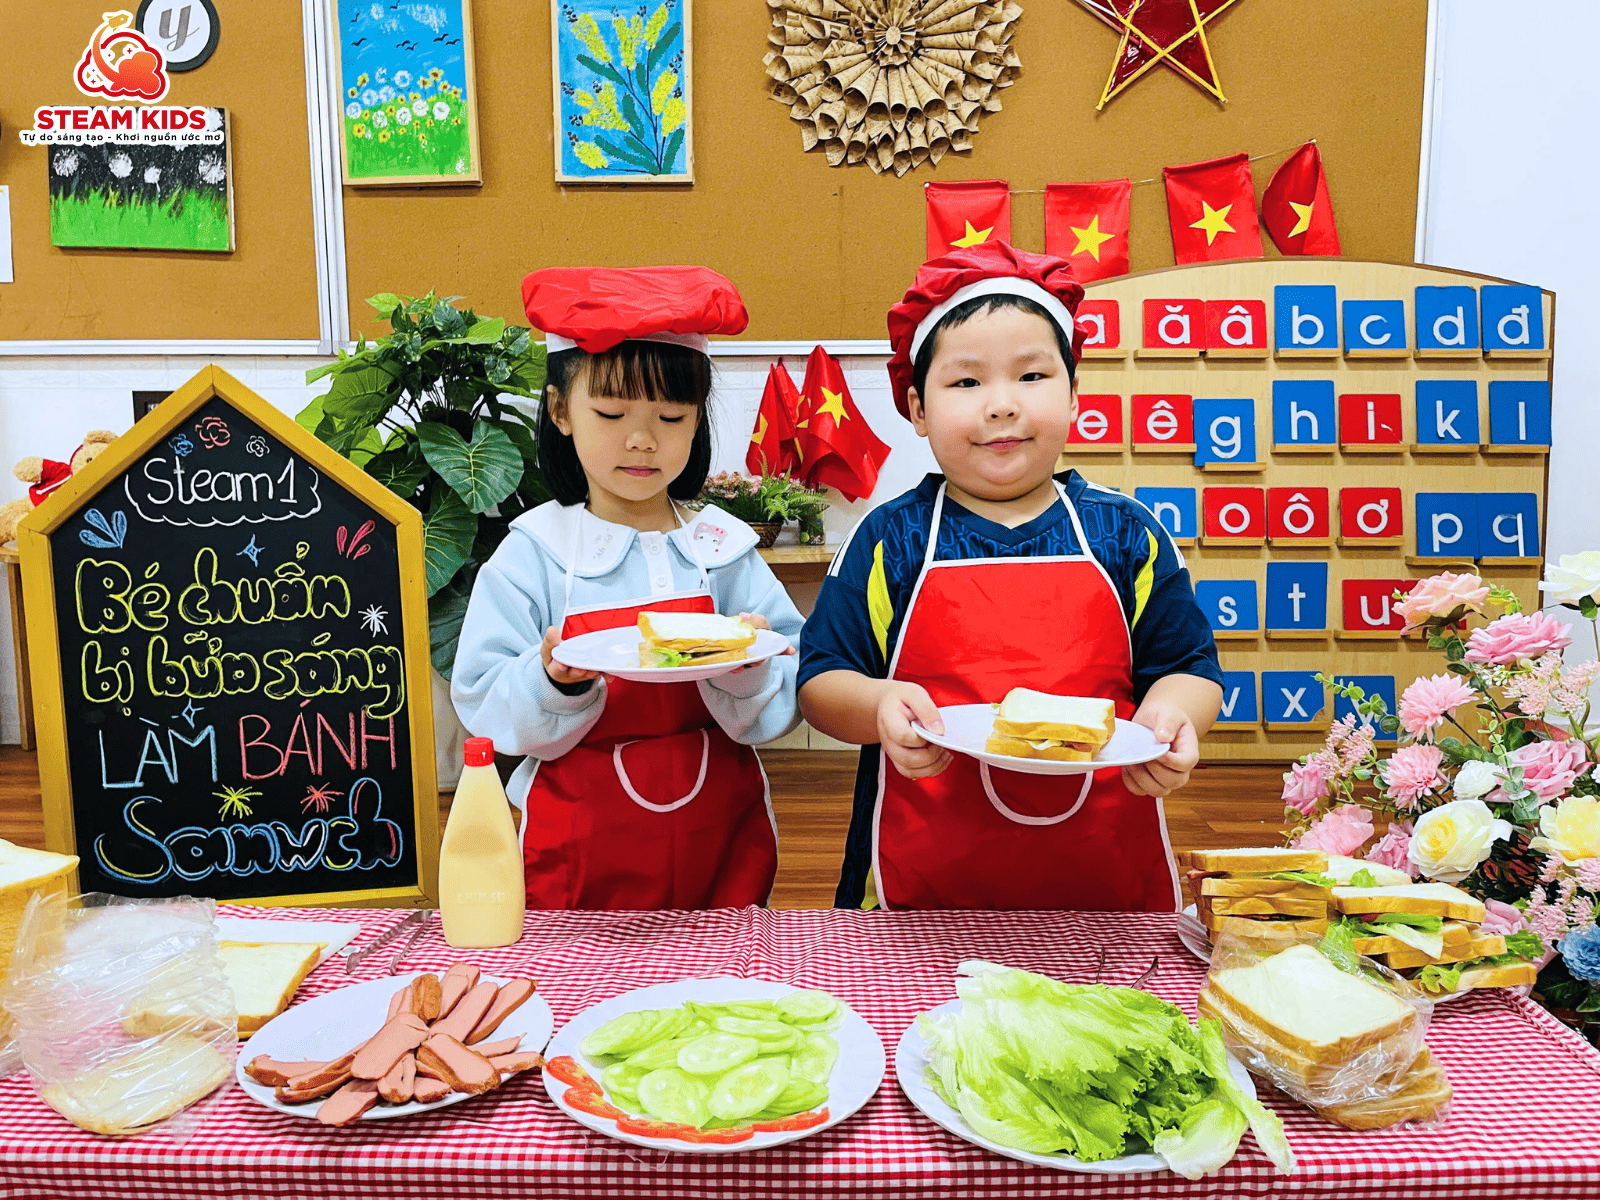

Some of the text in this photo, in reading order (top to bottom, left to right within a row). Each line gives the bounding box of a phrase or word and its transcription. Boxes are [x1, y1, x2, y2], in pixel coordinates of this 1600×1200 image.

[159, 5, 200, 51] y
[1158, 304, 1191, 344] ă
[1220, 304, 1253, 345] â
[1292, 305, 1324, 345] b
[1359, 314, 1392, 345] c
[1433, 306, 1465, 345] d
[1497, 304, 1530, 345] đ
[1077, 409, 1108, 440] e
[1147, 400, 1178, 440] ê
[1209, 416, 1241, 459] g
[1290, 401, 1319, 440] h
[1436, 400, 1462, 440] k
[1154, 492, 1525, 557] n o ô ơ p q
[75, 541, 351, 634] Bé chuẩn
[1217, 583, 1391, 627] s t u
[82, 630, 405, 720] bị bữa sáng
[1280, 687, 1309, 718] x
[98, 698, 397, 790] LÀM BÁNH
